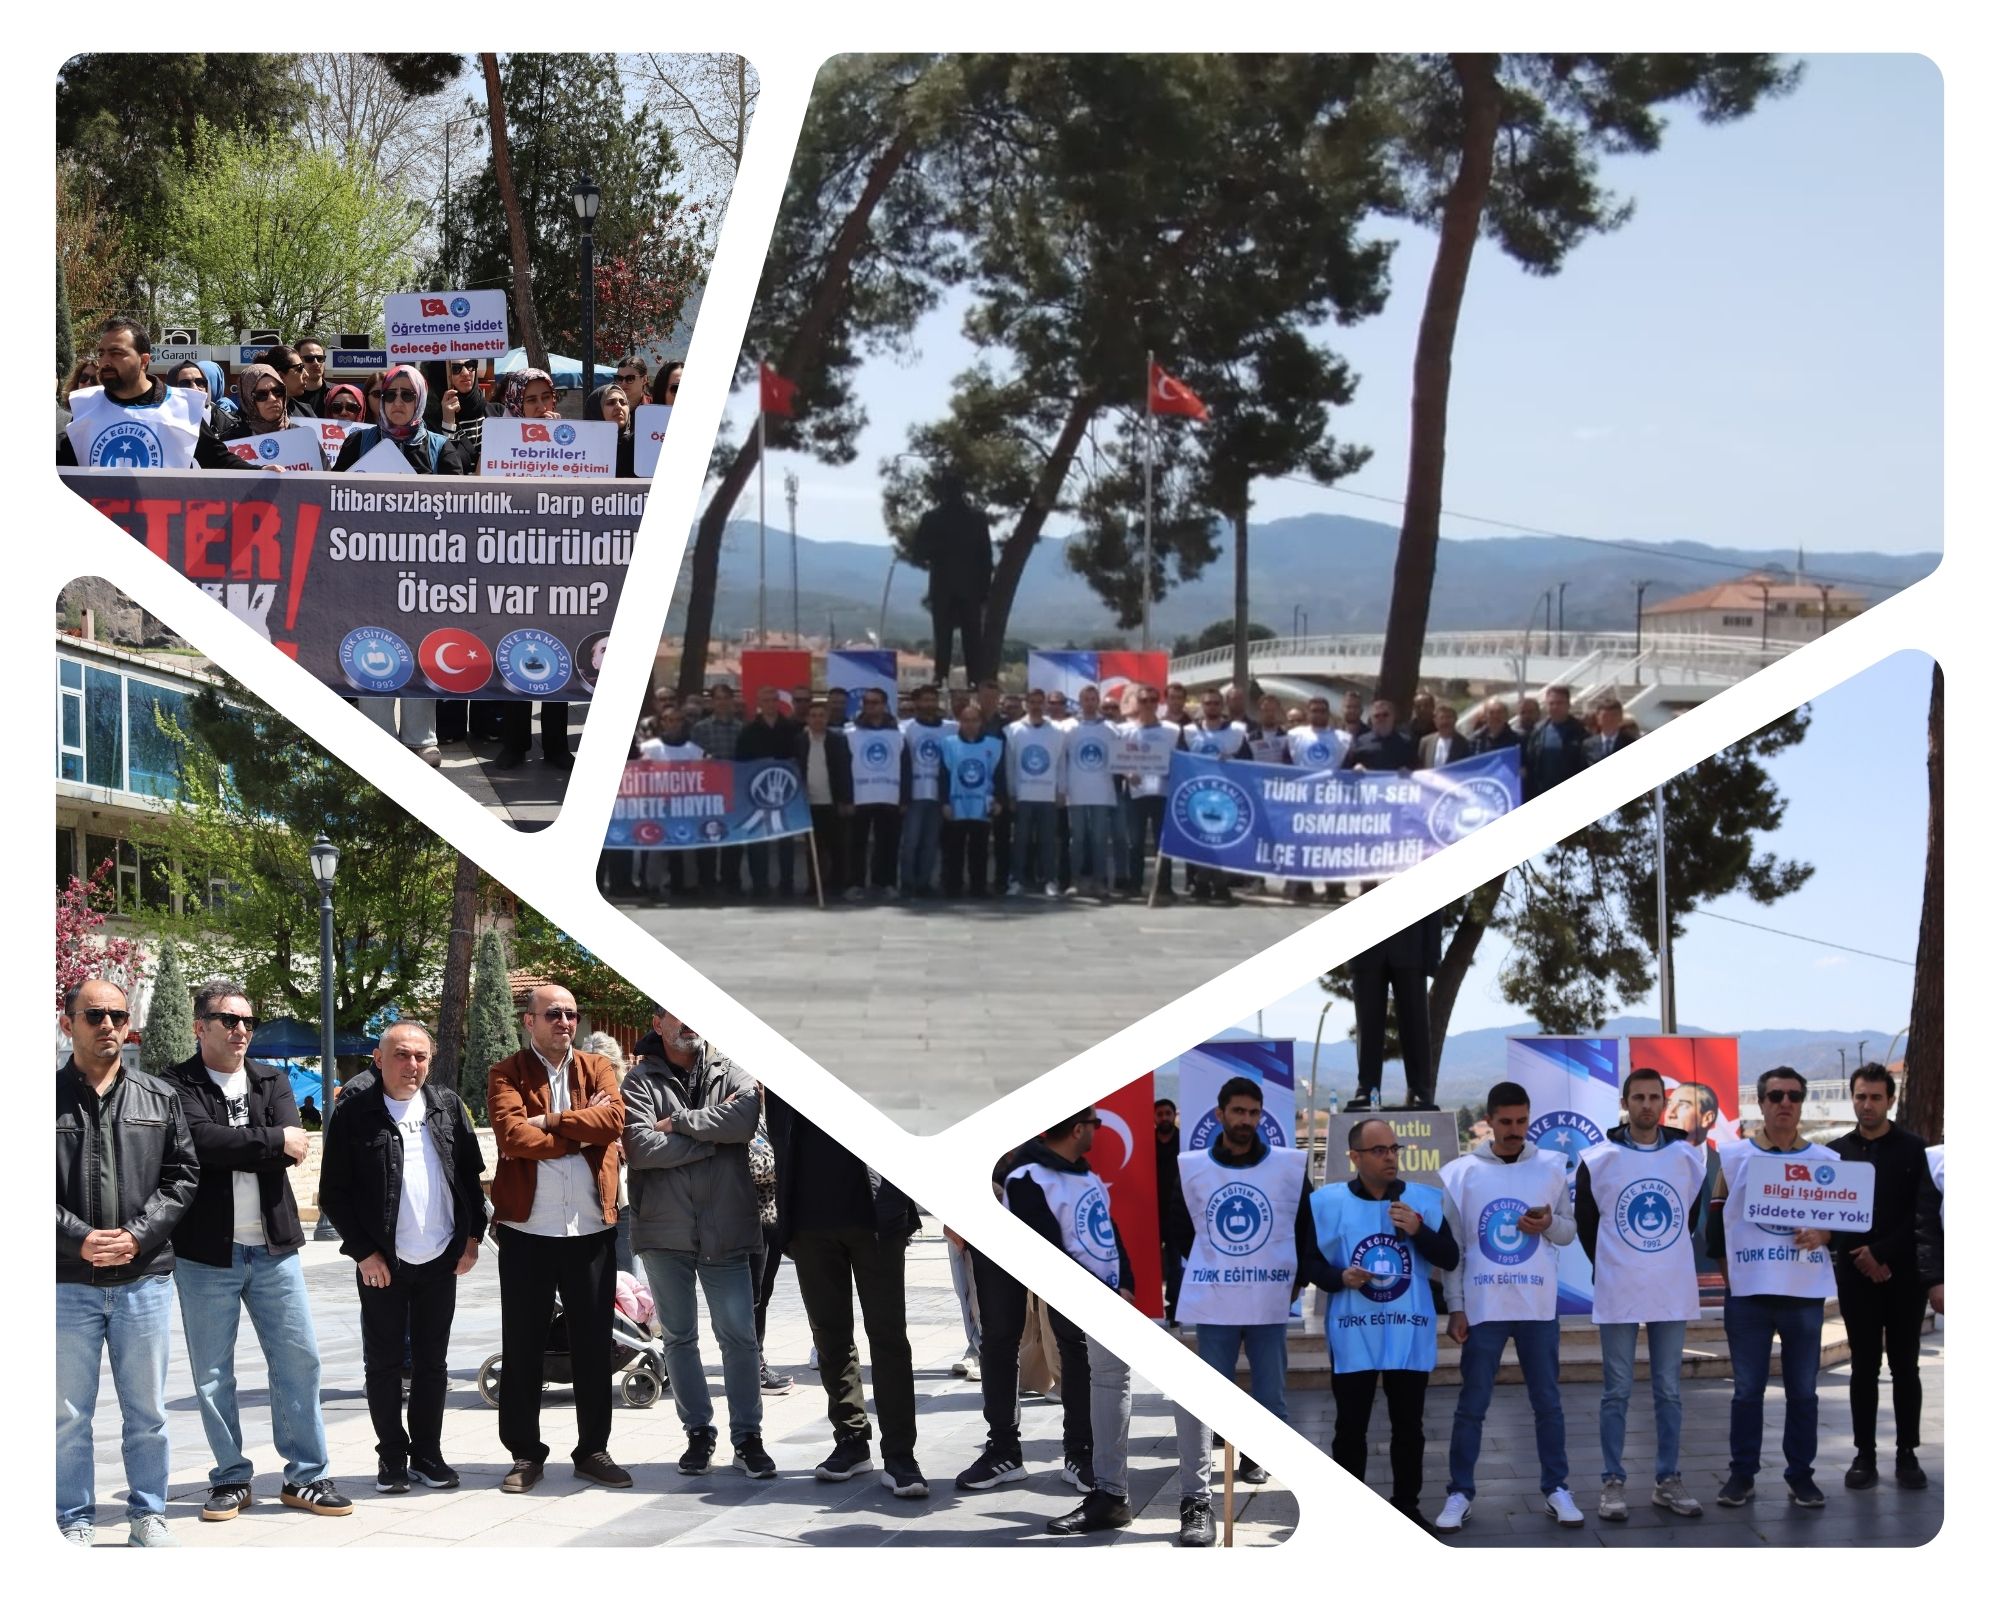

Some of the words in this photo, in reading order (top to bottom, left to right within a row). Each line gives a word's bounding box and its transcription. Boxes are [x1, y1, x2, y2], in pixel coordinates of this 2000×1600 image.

[391, 321, 461, 336] Öğretmene
[463, 319, 504, 334] Şiddet
[161, 349, 198, 360] Garanti
[390, 341, 447, 355] Geleceğe
[450, 339, 506, 352] İhanettir
[92, 436, 109, 465] TÜRK
[110, 426, 147, 438] EĞİTİM
[510, 447, 586, 460] Tebrikler!
[487, 460, 498, 470] El
[500, 460, 560, 473] birliğiyle
[562, 462, 610, 474] eğitimi
[330, 484, 531, 521] İtibarsızlaştırıldık...
[537, 491, 585, 519] Darp
[329, 526, 467, 564] Sonunda
[476, 526, 638, 567] öldürüldü
[398, 571, 478, 614] Ötesi
[486, 584, 540, 615] var
[547, 580, 609, 616] mı?
[344, 638, 357, 664] TÜRK
[355, 629, 410, 663] EĞİTİM-SEN
[499, 634, 521, 678] TÜRKİYE
[525, 631, 570, 677] KAMU-SEN
[371, 679, 396, 690] 1992
[528, 682, 551, 692] 1992
[618, 765, 705, 796] ĞİTİMCİYE
[1262, 777, 1308, 803] TÜRK
[1314, 780, 1422, 805] EĞİTİM-SEN
[671, 795, 725, 817] HAYIR
[1292, 812, 1392, 835] OSMANCIK
[1255, 837, 1297, 871] İLÇE
[1301, 838, 1425, 869] TEMSİLCİLİĞİ
[1763, 1184, 1795, 1199] Bilgi
[1798, 1186, 1858, 1201] Işığında
[1618, 1188, 1638, 1234] TÜRKİYE
[1640, 1183, 1671, 1197] KAMU
[1672, 1207, 1681, 1229] SEN
[1748, 1203, 1806, 1219] Şiddete
[1811, 1208, 1835, 1221] Yer
[1838, 1210, 1870, 1224] Yok!
[1642, 1239, 1662, 1248] 1992
[1735, 1247, 1765, 1263] TÜRK
[1192, 1267, 1220, 1283] TÜRK
[1224, 1265, 1291, 1283] EĞİTİM-SEN
[1473, 1272, 1495, 1287] TÜRK
[1338, 1314, 1367, 1329] TÜRK
